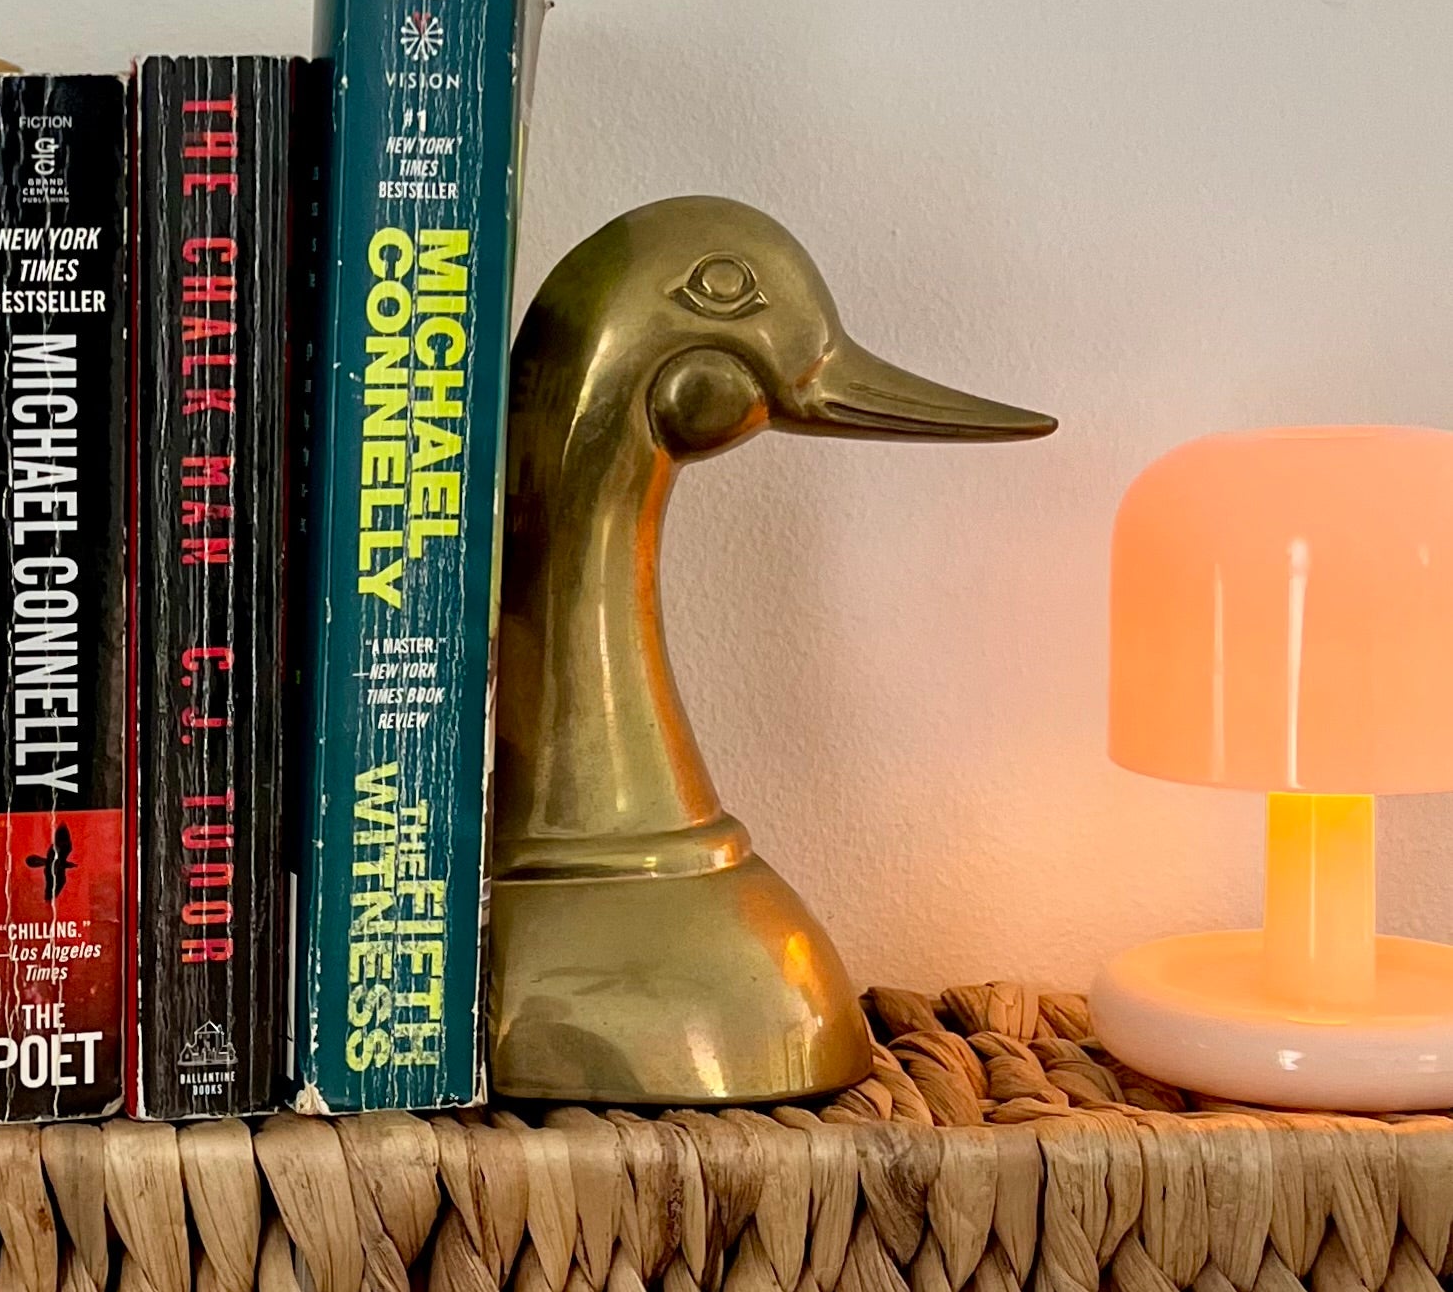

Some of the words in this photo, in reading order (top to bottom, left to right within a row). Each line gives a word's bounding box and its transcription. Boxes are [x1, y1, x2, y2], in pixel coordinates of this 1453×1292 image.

[385, 71, 461, 89] VISION
[19, 116, 73, 128] FICTION
[403, 108, 427, 133] #1
[180, 92, 239, 196] THE
[386, 136, 418, 155] NEW
[419, 136, 456, 155] YORK
[399, 159, 439, 177] TIMES
[22, 187, 69, 195] CENTRAL
[27, 178, 64, 186] GRAND
[379, 180, 458, 199] BESTSELLER
[49, 227, 102, 251] YORK
[20, 259, 80, 282] TIMES
[180, 236, 239, 416] CHALK
[408, 229, 470, 558] MICHAEL
[358, 227, 414, 610] CONNELLY
[12, 334, 79, 546] MICHAEL
[180, 455, 237, 567] MAN
[13, 556, 80, 793] CONNELLY
[402, 662, 438, 679] YORK
[367, 687, 404, 705] TIMES
[406, 686, 446, 705] BOOK
[377, 711, 430, 731] REVIEW
[397, 798, 428, 878] THE
[181, 789, 235, 964] TUDOR
[347, 760, 399, 1072] WITNESS
[41, 942, 102, 962] Angeles
[25, 964, 68, 982] Times
[392, 879, 445, 1067] FIFTH
[21, 1003, 66, 1030] THE
[179, 1071, 236, 1085] BALLANTINE
[192, 1084, 223, 1096] BOOKS
